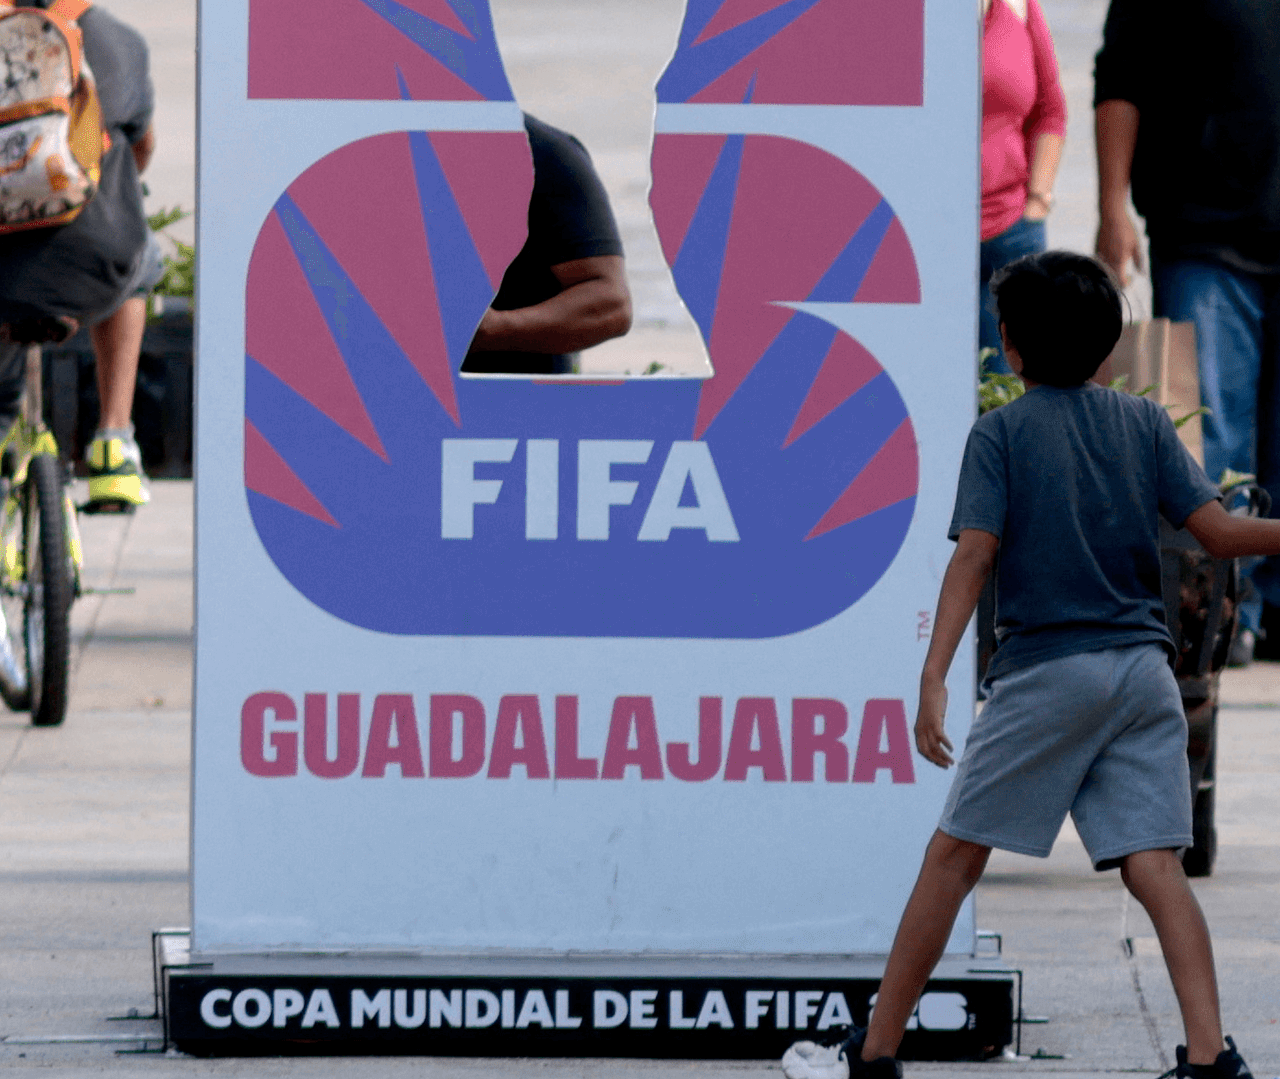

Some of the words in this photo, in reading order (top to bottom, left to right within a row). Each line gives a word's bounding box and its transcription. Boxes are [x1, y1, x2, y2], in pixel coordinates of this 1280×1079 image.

[440, 438, 741, 543] FIFA
[240, 692, 916, 784] GUADALAJARA
[200, 988, 340, 1029] COPA
[350, 989, 583, 1029] MUNDIAL
[593, 990, 658, 1029] DE
[669, 990, 735, 1029] LA
[745, 990, 854, 1030] FIFA
